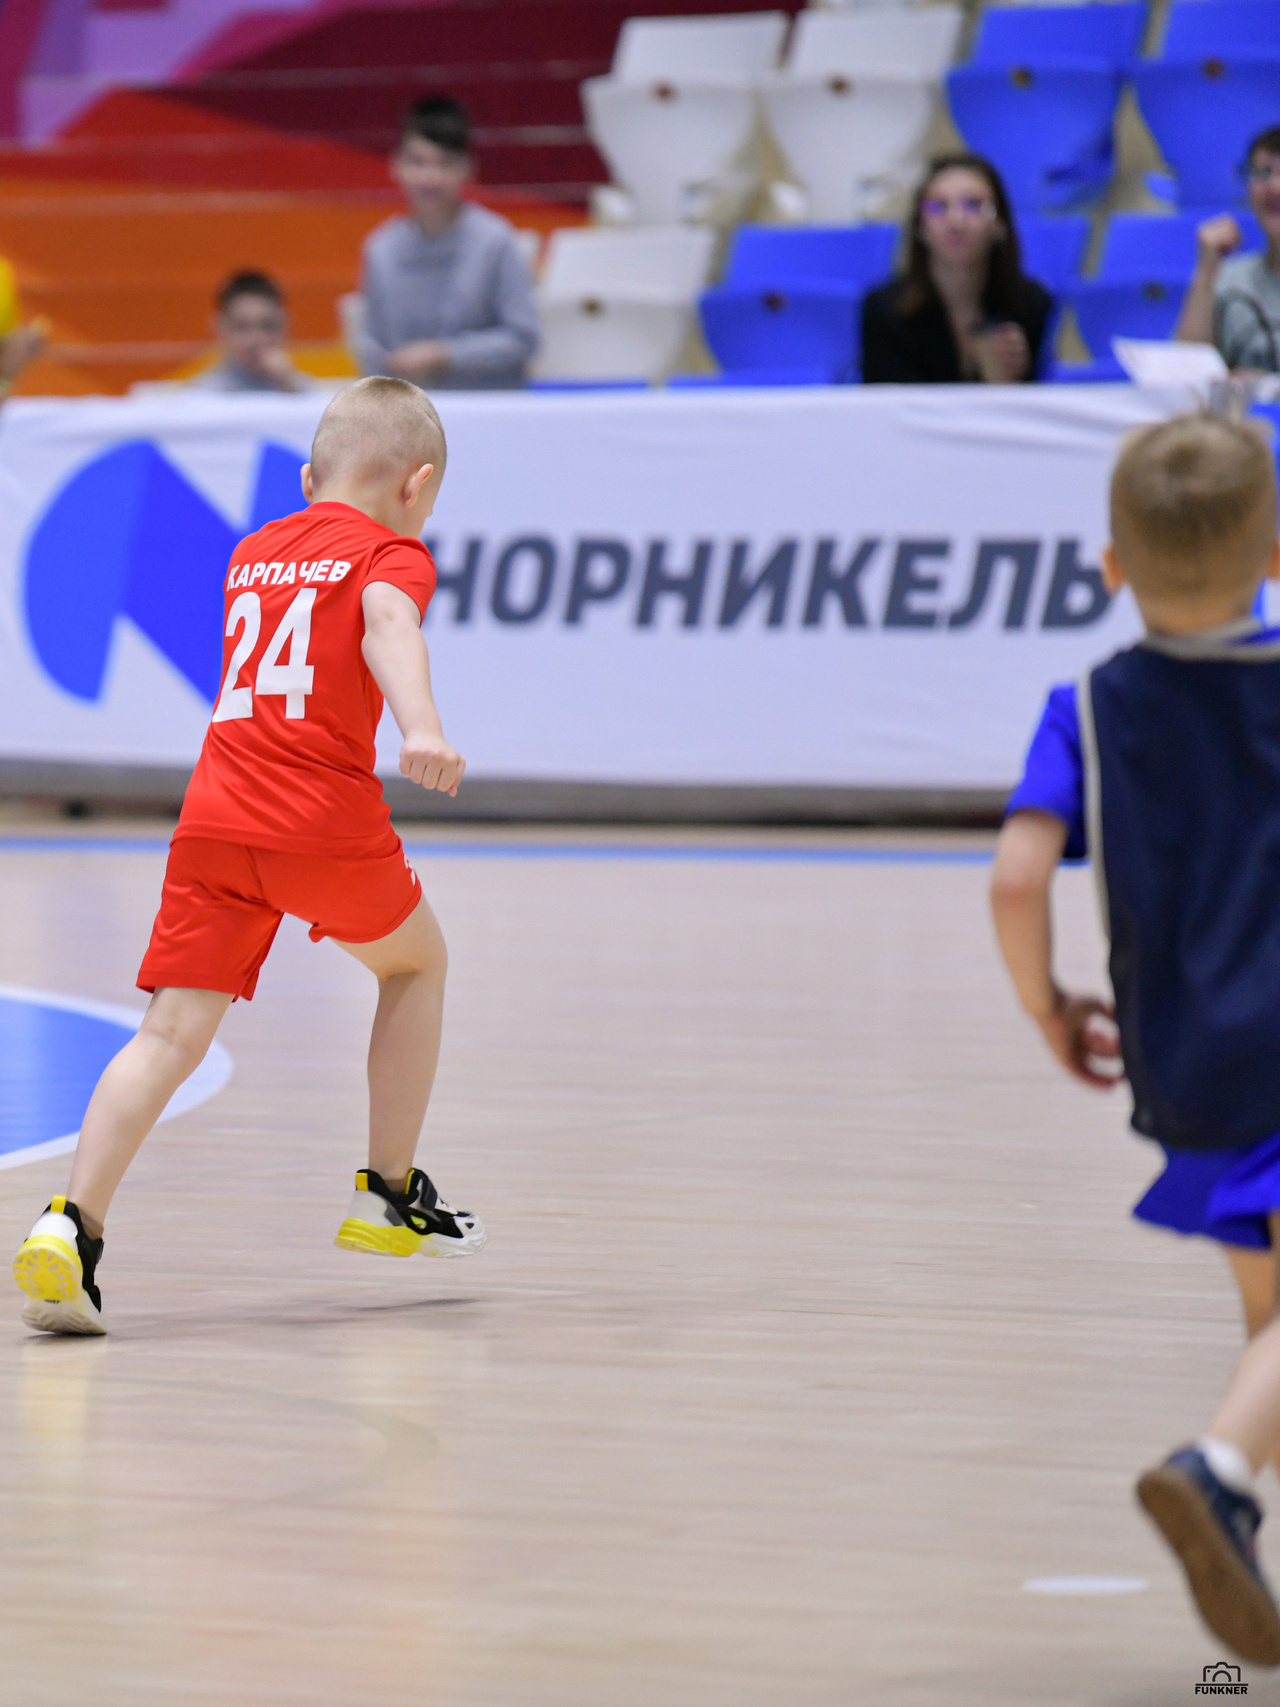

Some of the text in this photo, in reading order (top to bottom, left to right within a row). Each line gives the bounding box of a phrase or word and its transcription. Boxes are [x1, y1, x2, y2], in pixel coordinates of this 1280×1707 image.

[226, 559, 352, 591] КАРПАЧЕВ
[422, 533, 1112, 630] НОРНИКЕЛЬ
[212, 588, 317, 722] 24
